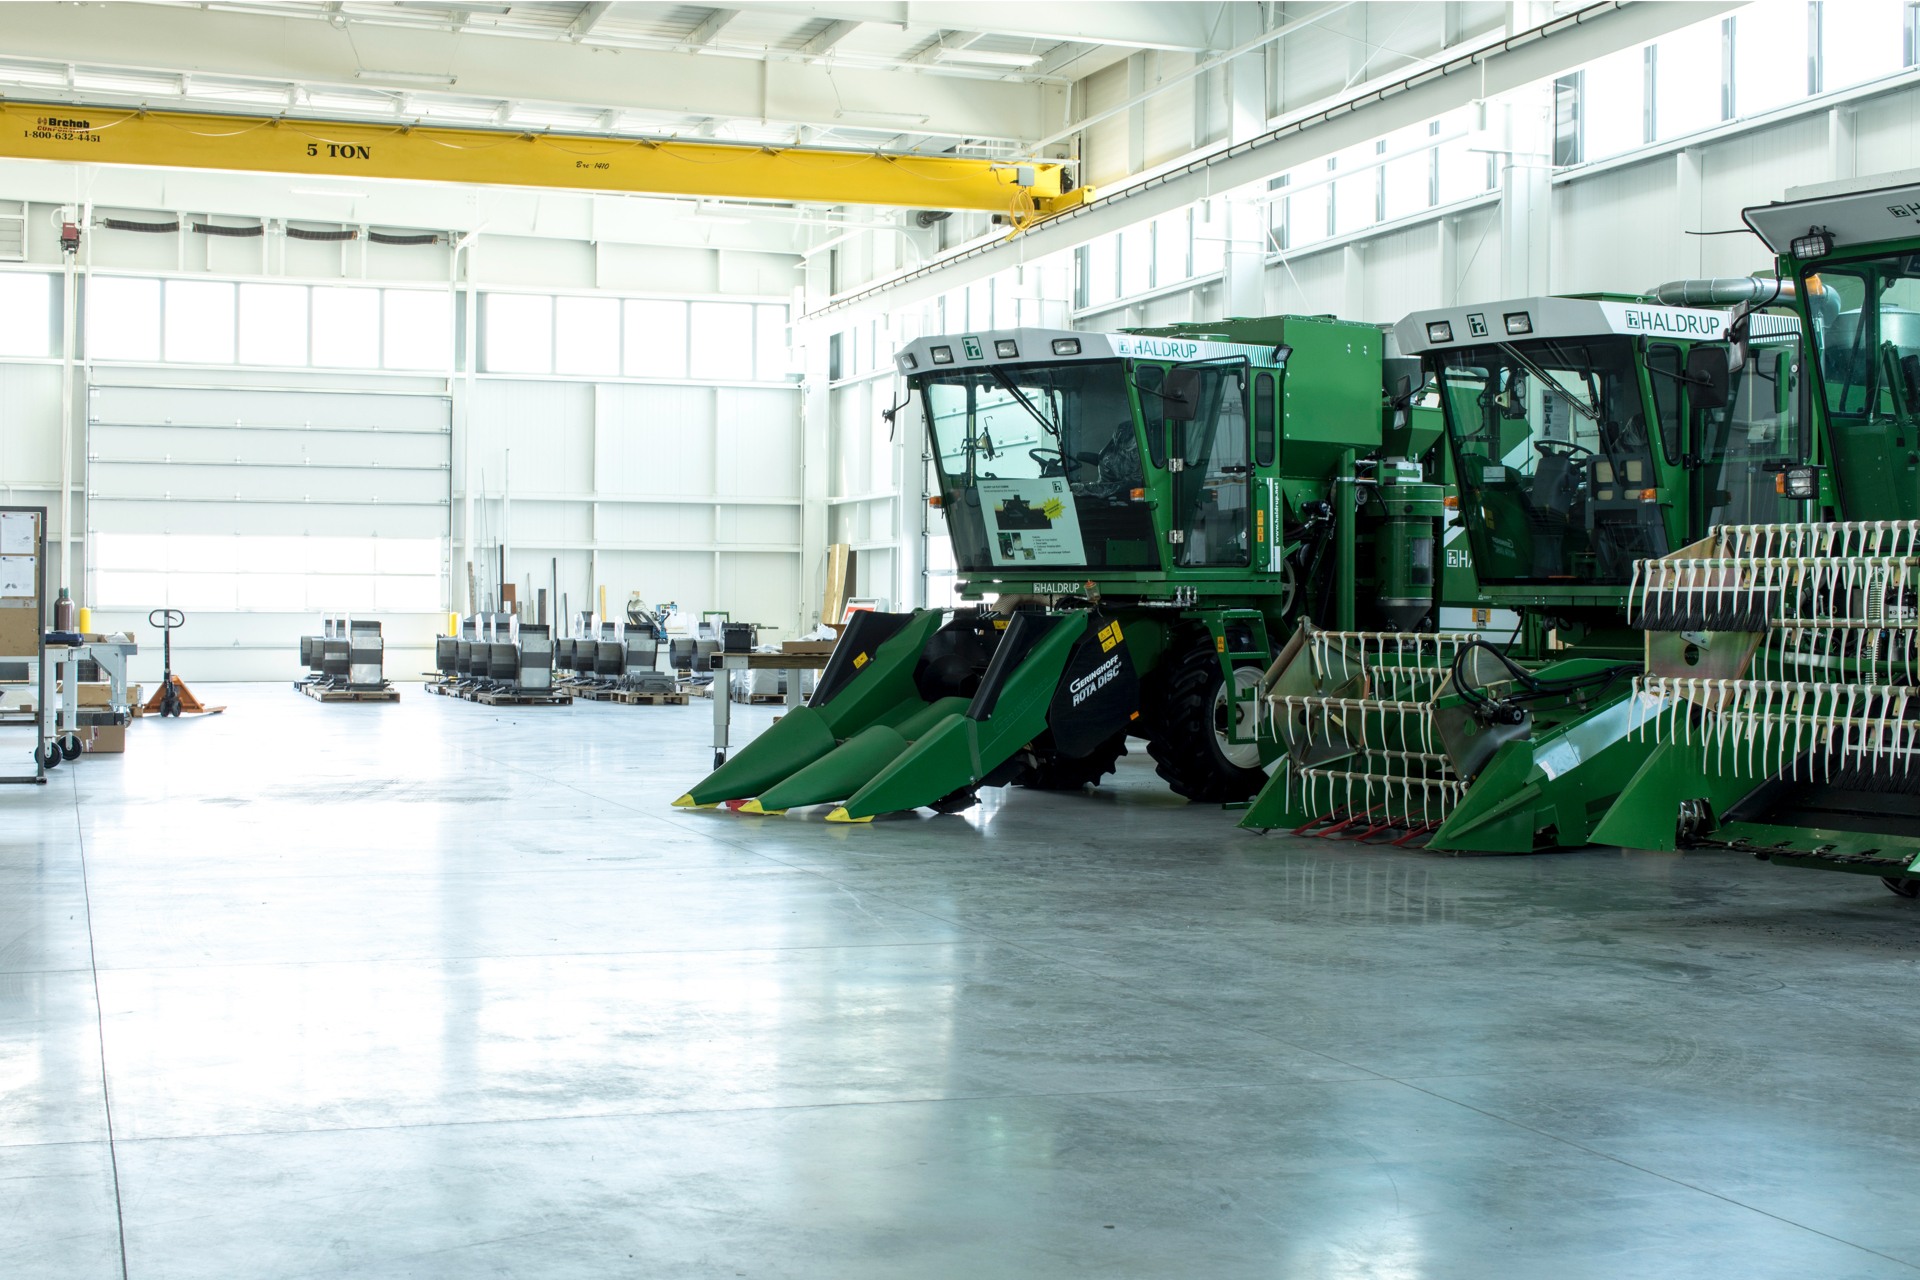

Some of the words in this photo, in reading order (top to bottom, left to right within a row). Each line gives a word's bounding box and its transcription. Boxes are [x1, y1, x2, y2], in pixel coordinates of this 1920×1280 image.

[48, 117, 90, 129] Brehob
[24, 130, 101, 143] 1-800-632-4451
[306, 143, 318, 157] 5
[326, 144, 371, 160] TON
[1640, 311, 1720, 335] HALDRUP
[1134, 340, 1197, 358] HALDRUP
[1040, 582, 1080, 593] HALDRUP
[1069, 654, 1119, 694] GERINGHOFF
[1072, 681, 1097, 707] ROTA
